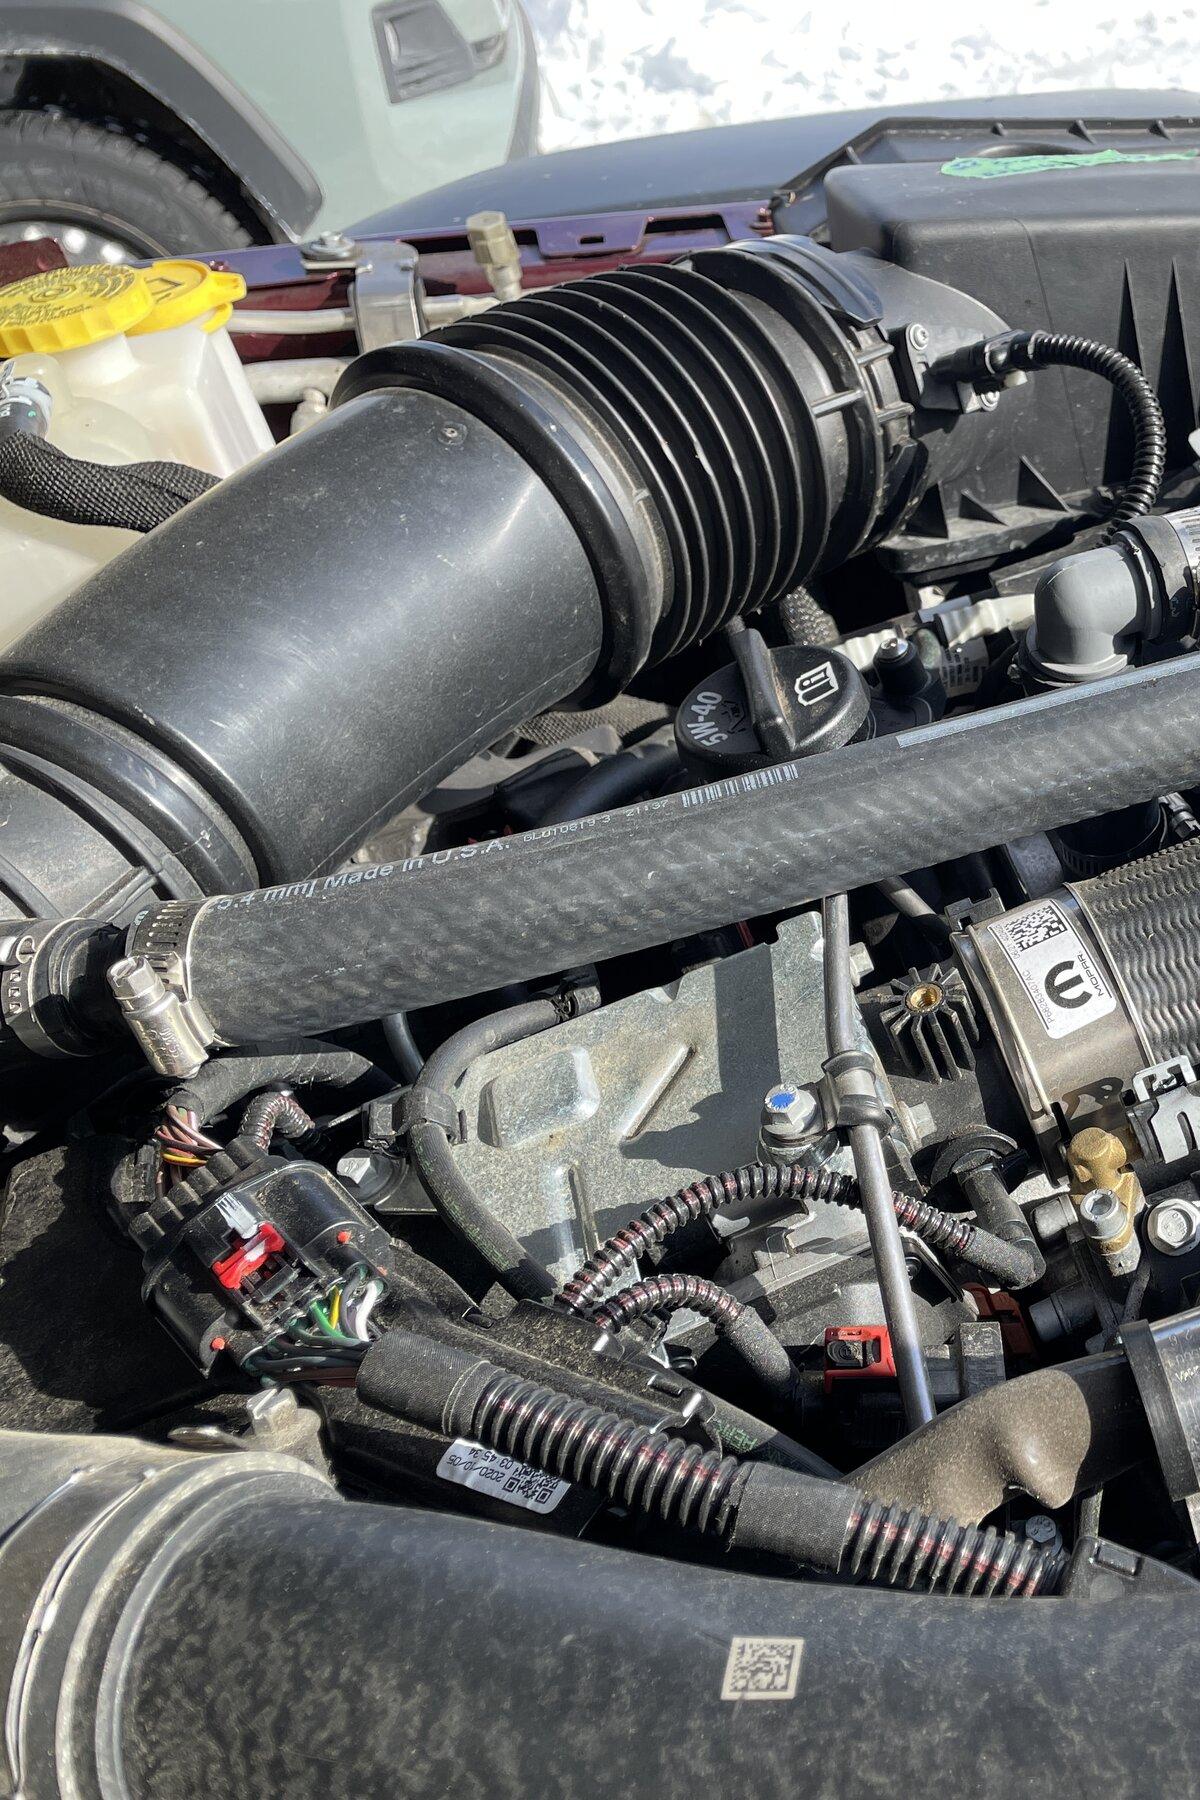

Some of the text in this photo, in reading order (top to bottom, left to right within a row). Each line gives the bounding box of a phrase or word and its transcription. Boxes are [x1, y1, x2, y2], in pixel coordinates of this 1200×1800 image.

[687, 691, 728, 746] 5W-40
[323, 862, 395, 891] Made
[431, 838, 510, 865] U.S.A.
[1077, 954, 1104, 997] MOPAR
[446, 1454, 506, 1483] 2020/10/05
